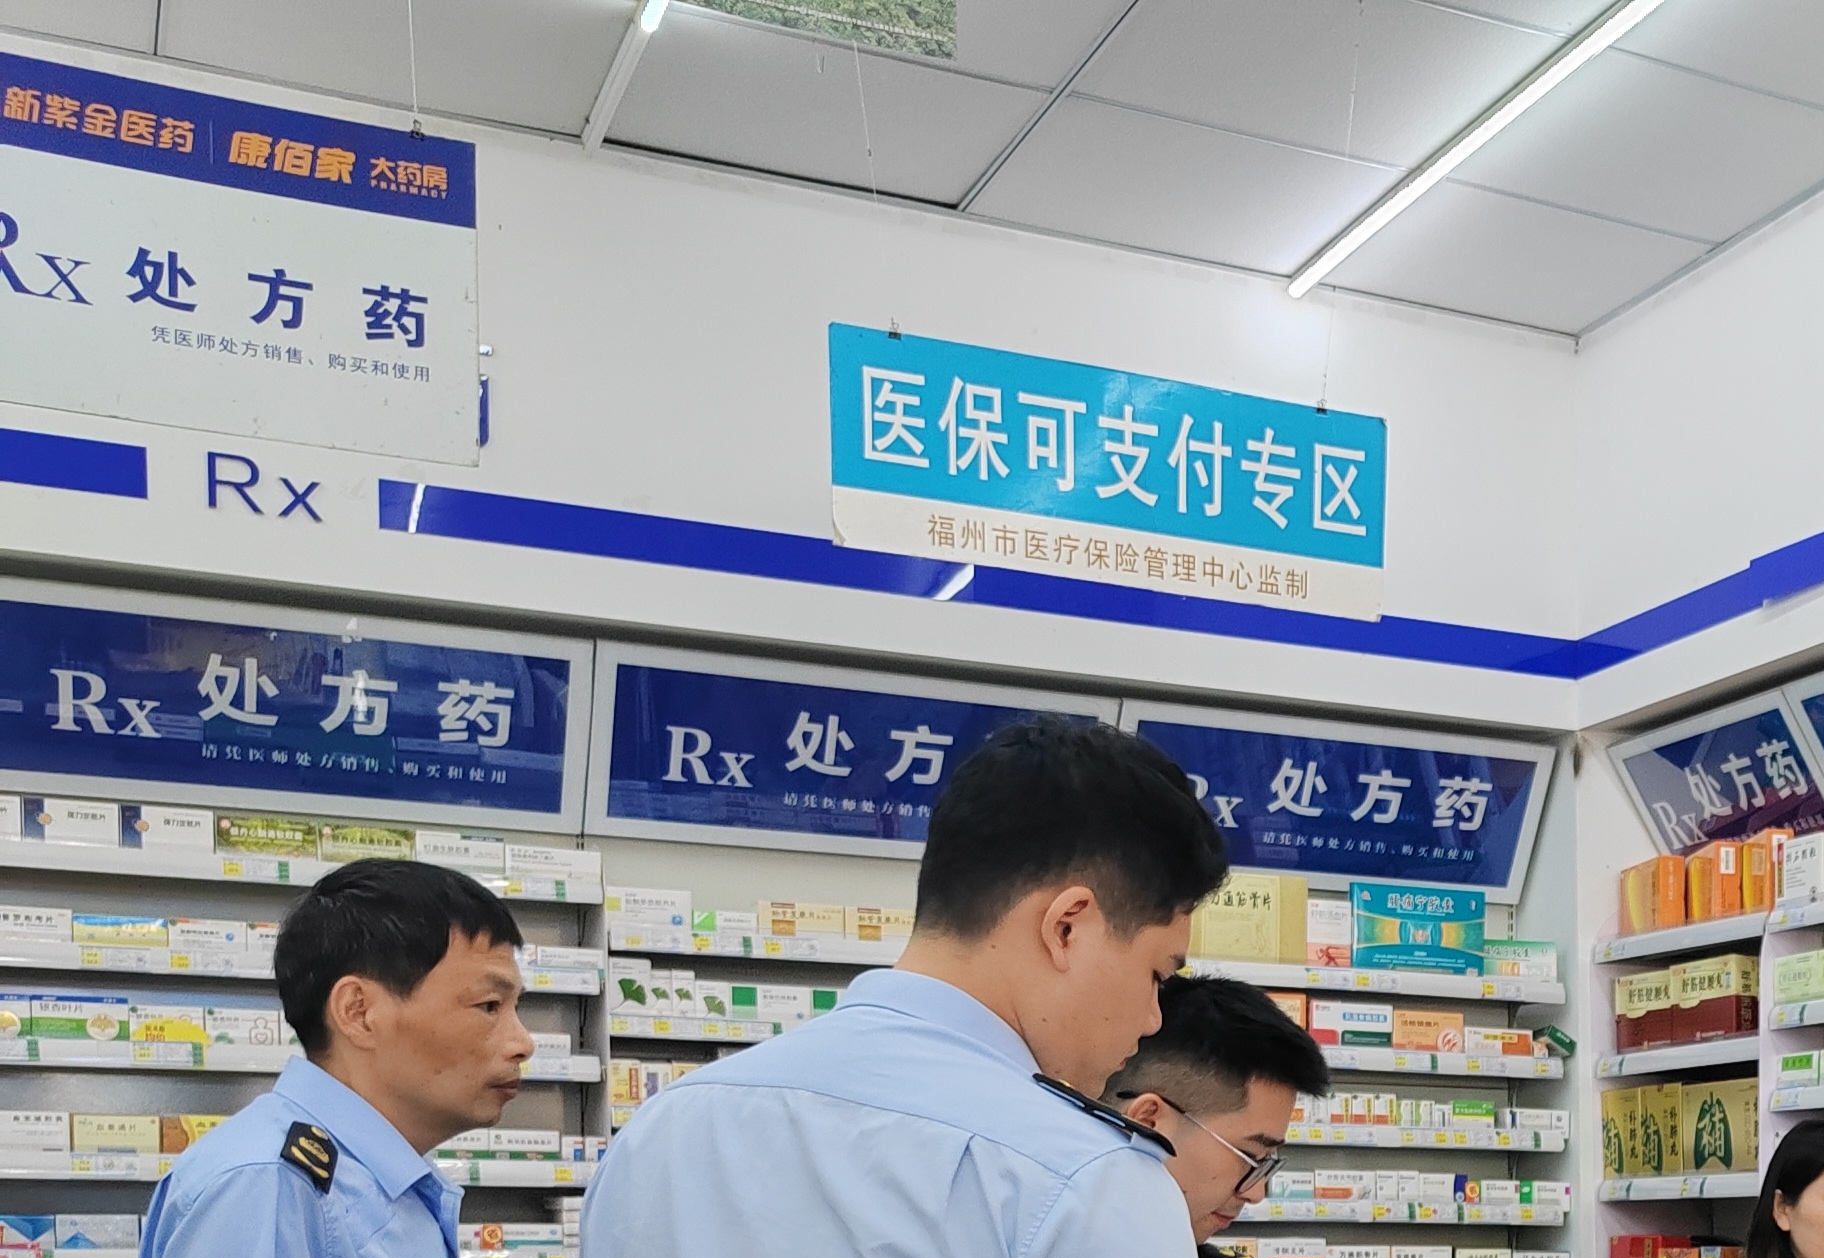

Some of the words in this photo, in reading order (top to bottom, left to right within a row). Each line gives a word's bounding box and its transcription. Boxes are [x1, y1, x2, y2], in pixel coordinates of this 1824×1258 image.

[4, 86, 195, 153] 新紫金医药
[229, 131, 355, 184] 康佰家
[370, 157, 447, 191] 大药房
[127, 247, 428, 348] 处方药
[151, 325, 431, 382] 凭医师处方销售、购买和使用
[207, 451, 323, 523] Rx
[861, 366, 1367, 537] 医保可支付专区
[927, 514, 1310, 601] 福州市医疗保险管理中心监制
[50, 668, 161, 739] Rx
[199, 652, 515, 747] 处方药
[664, 726, 753, 790] Rx
[785, 711, 954, 787] 处方
[1270, 759, 1495, 832] 处方药
[1652, 799, 1705, 852] Rx
[1683, 739, 1809, 819] 处方药
